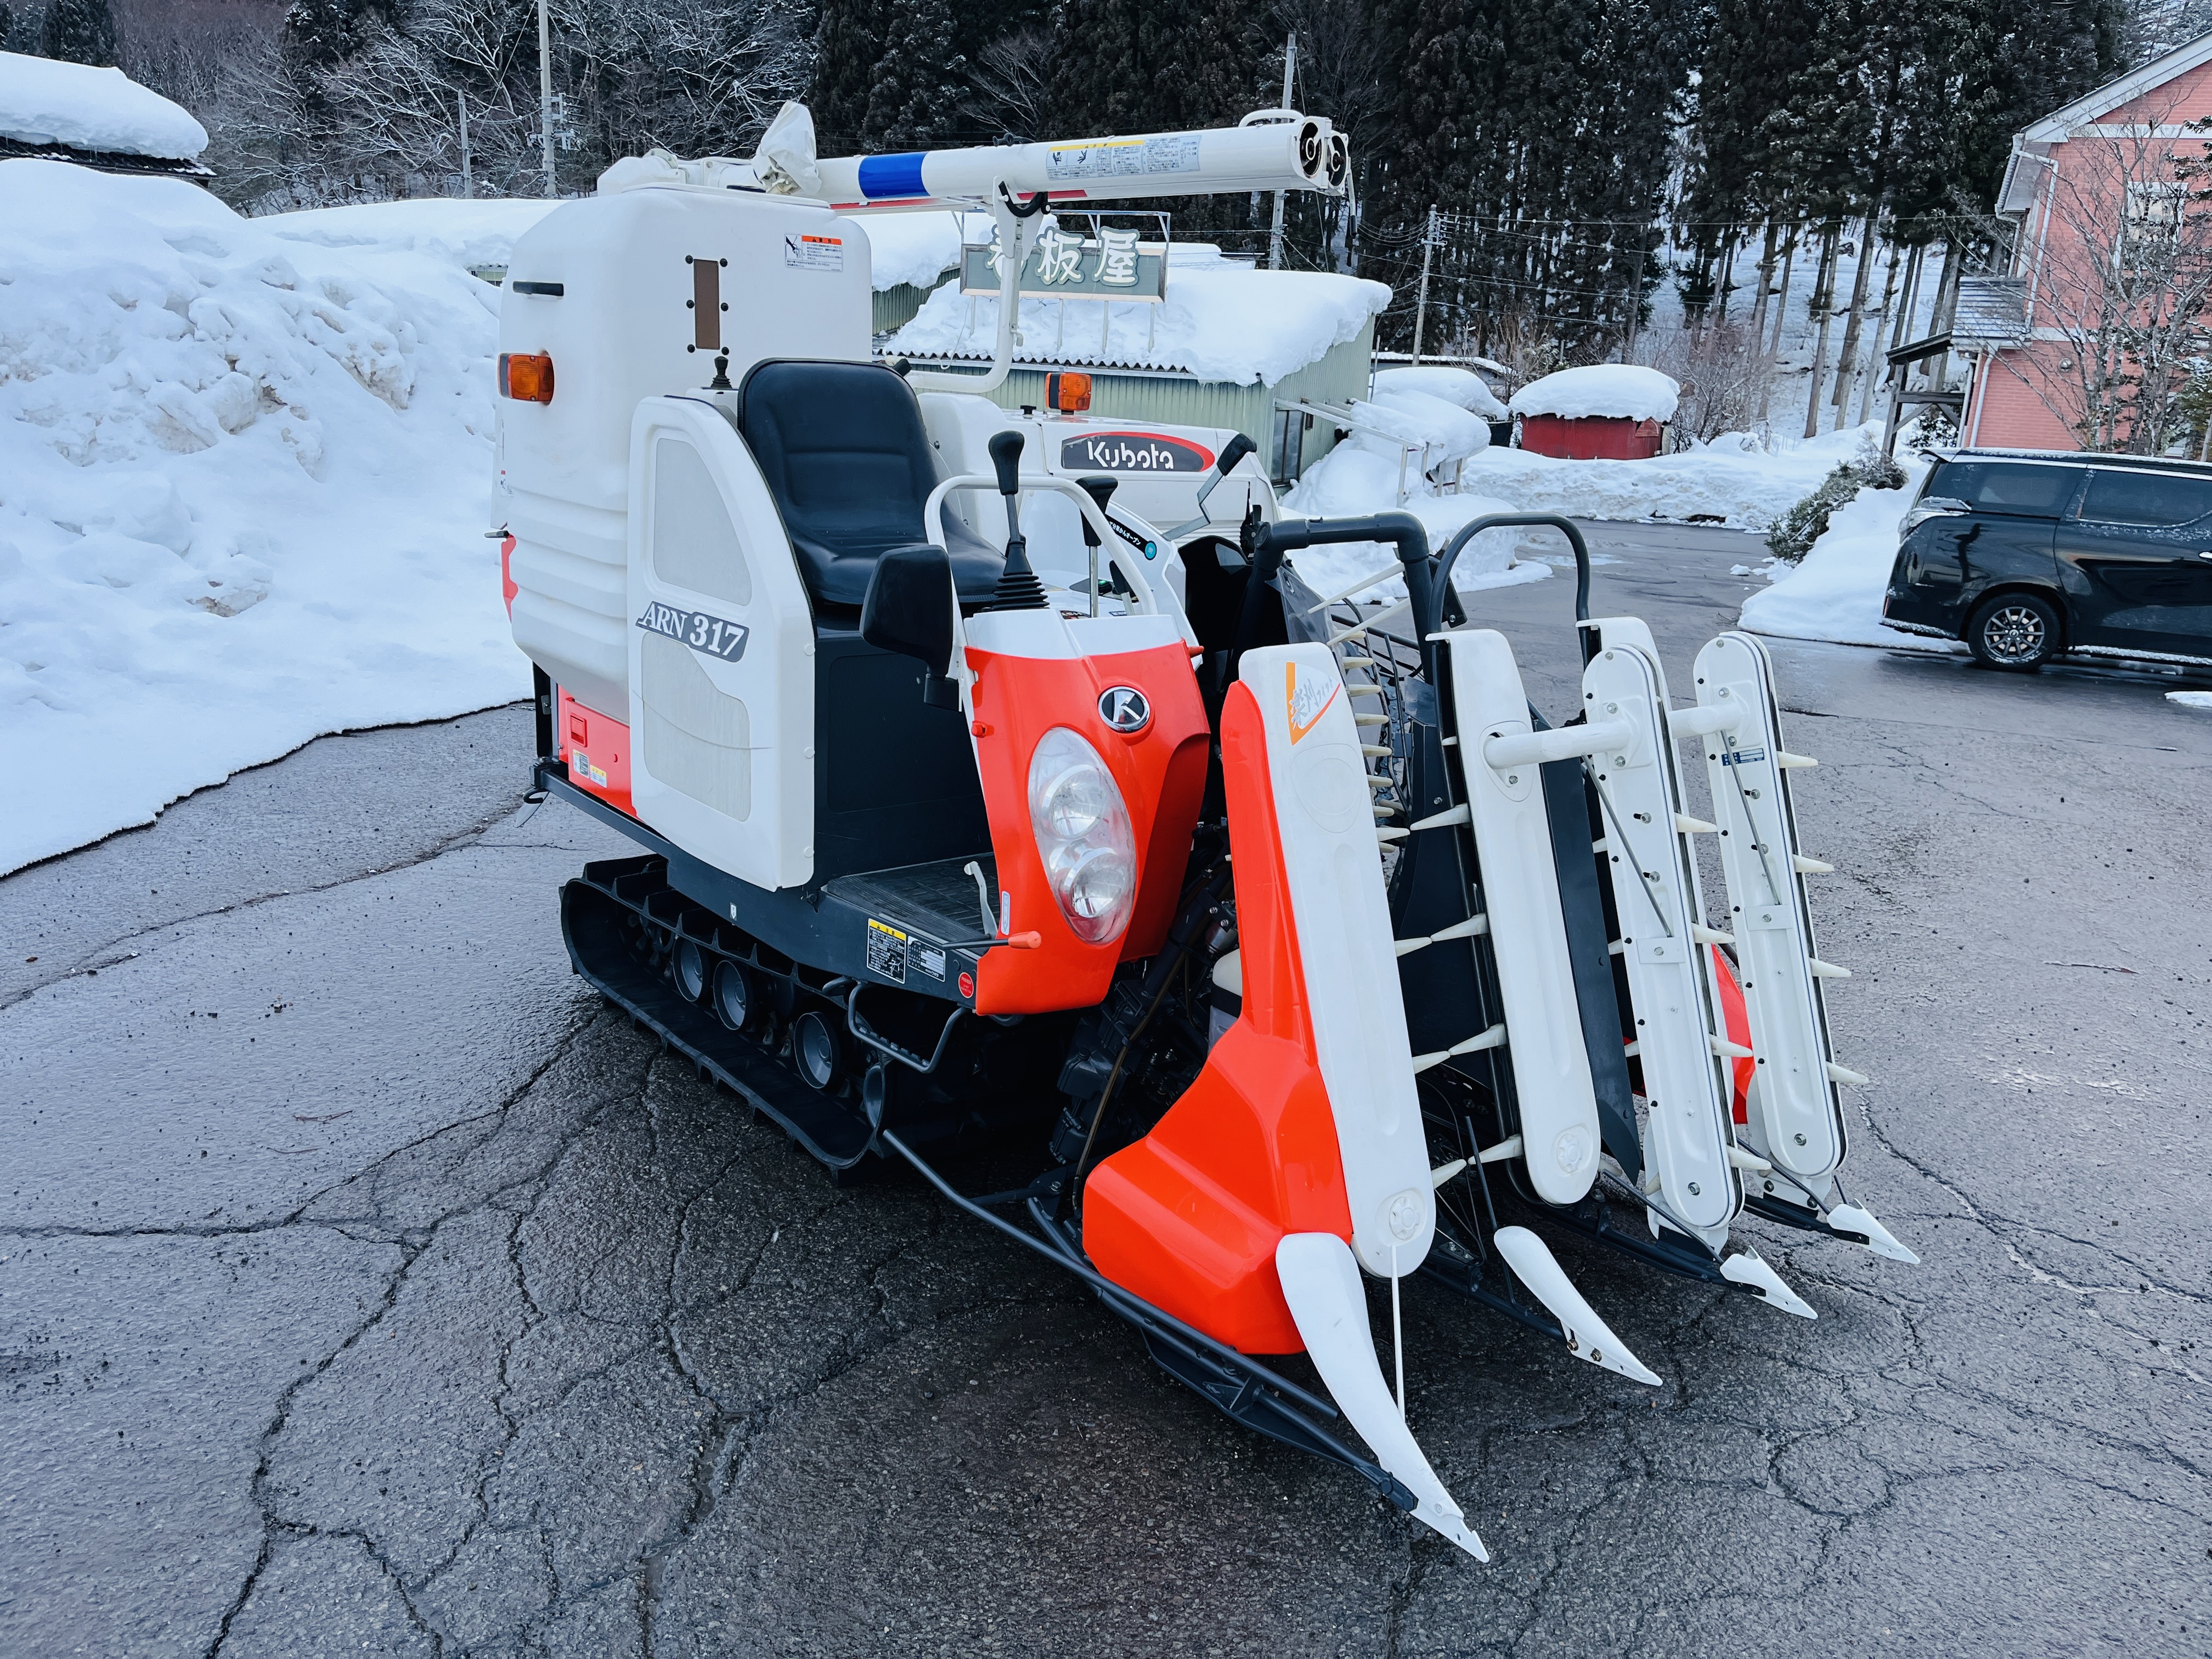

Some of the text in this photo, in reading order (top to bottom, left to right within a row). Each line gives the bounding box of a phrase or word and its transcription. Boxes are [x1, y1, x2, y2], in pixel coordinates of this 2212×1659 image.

[1087, 441, 1174, 470] Kubota
[637, 603, 745, 656] ARN 317
